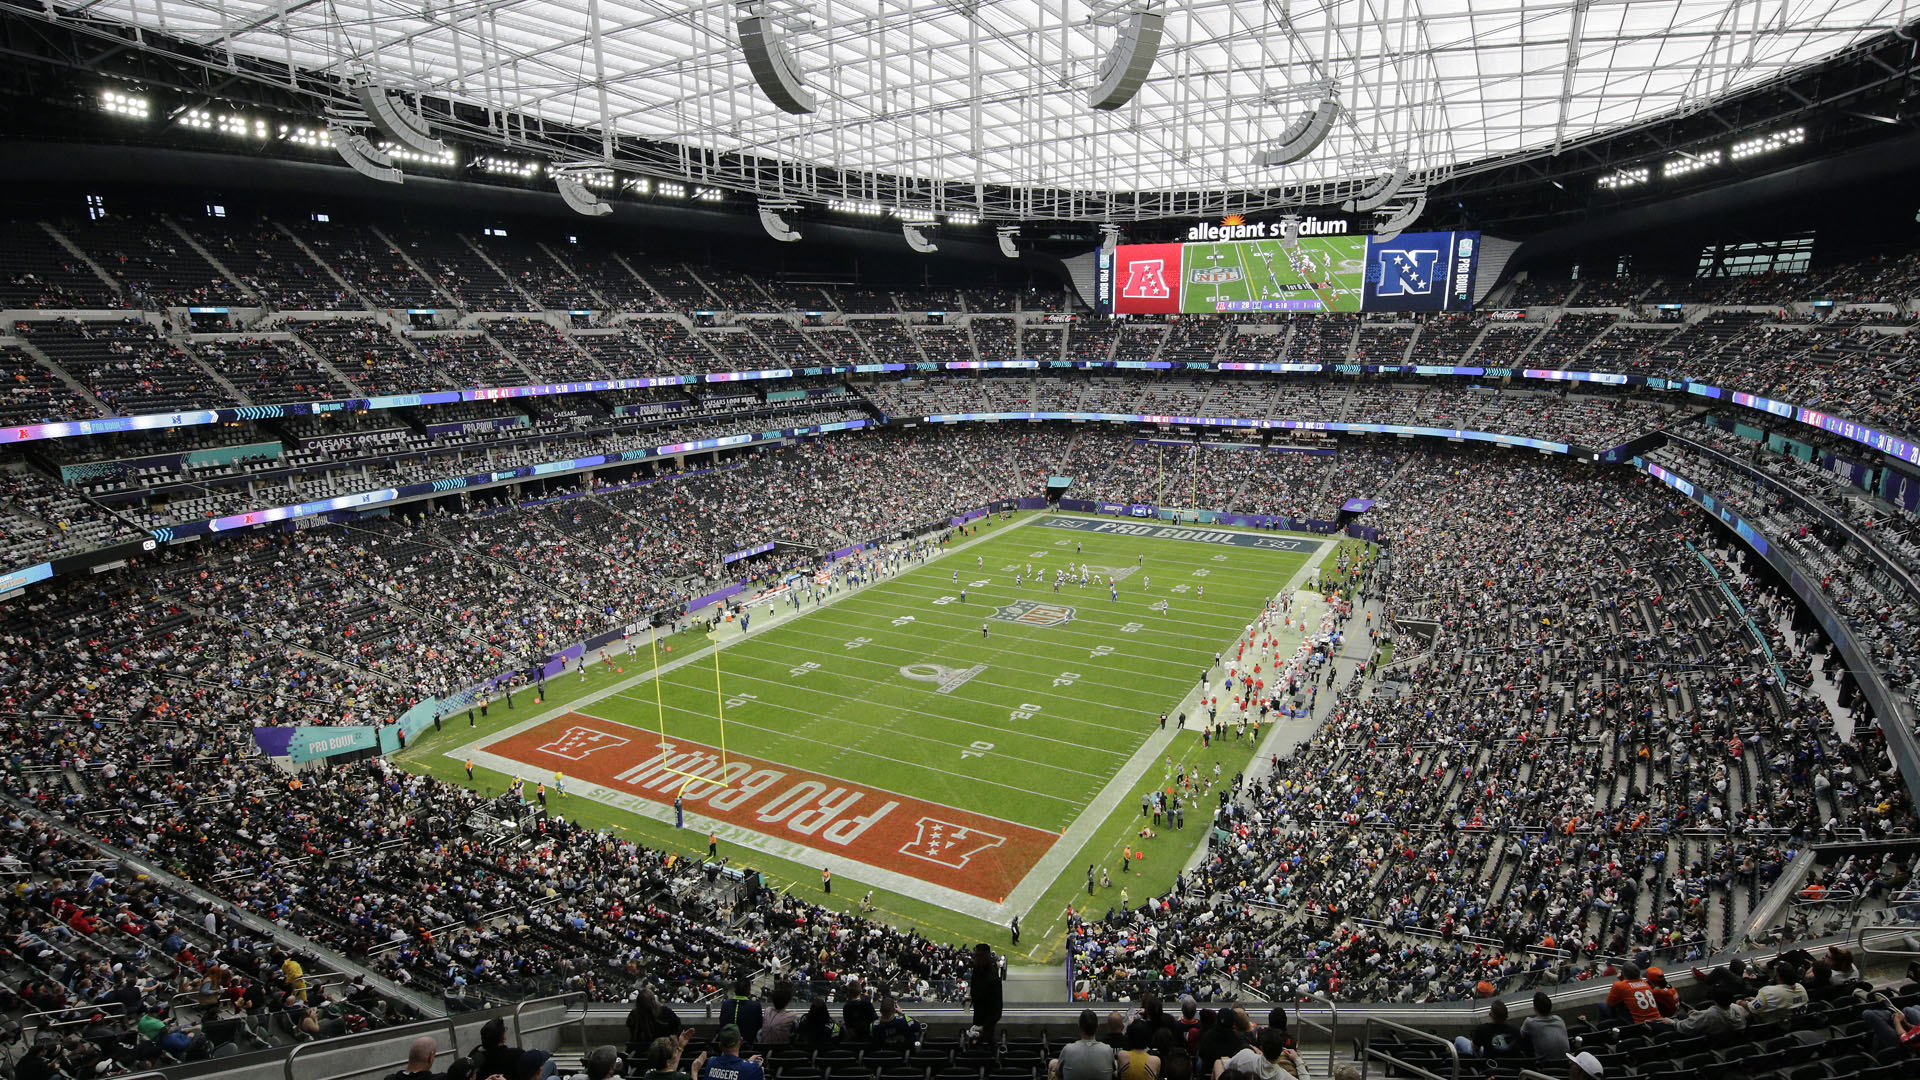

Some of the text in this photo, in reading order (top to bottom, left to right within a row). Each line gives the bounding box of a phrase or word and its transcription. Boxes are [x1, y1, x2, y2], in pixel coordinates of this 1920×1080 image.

[1188, 216, 1347, 242] allegiant stdium
[1377, 250, 1438, 296] N
[1457, 258, 1470, 273] PRO
[1100, 270, 1109, 282] PRO
[1123, 259, 1169, 298] A
[1199, 273, 1236, 281] NFL
[1455, 274, 1470, 295] BOWL
[1100, 283, 1109, 301] BOWL
[501, 389, 508, 397] 41
[92, 423, 104, 431] PRO
[105, 421, 121, 430] BOWL
[463, 423, 476, 433] PRO
[308, 437, 351, 449] CAESARS
[381, 431, 406, 441] SEATS
[296, 520, 309, 529] PRO
[311, 515, 328, 527] BOWL
[1093, 522, 1236, 545] PRO BOWL
[1018, 606, 1068, 624] NFL
[1089, 646, 1115, 658] 40
[789, 661, 821, 677] 20
[1053, 672, 1081, 687] 30
[725, 693, 758, 709] 10
[1010, 703, 1042, 721] 20
[309, 741, 328, 754] PRO
[329, 735, 357, 750] BOWL
[960, 740, 995, 759] 10
[587, 789, 618, 800] US
[613, 743, 900, 845] PRO BOWL
[618, 801, 648, 811] OF
[699, 821, 771, 848] TAKES
[1634, 990, 1657, 1010] 88
[709, 1067, 739, 1080] RODGERS
